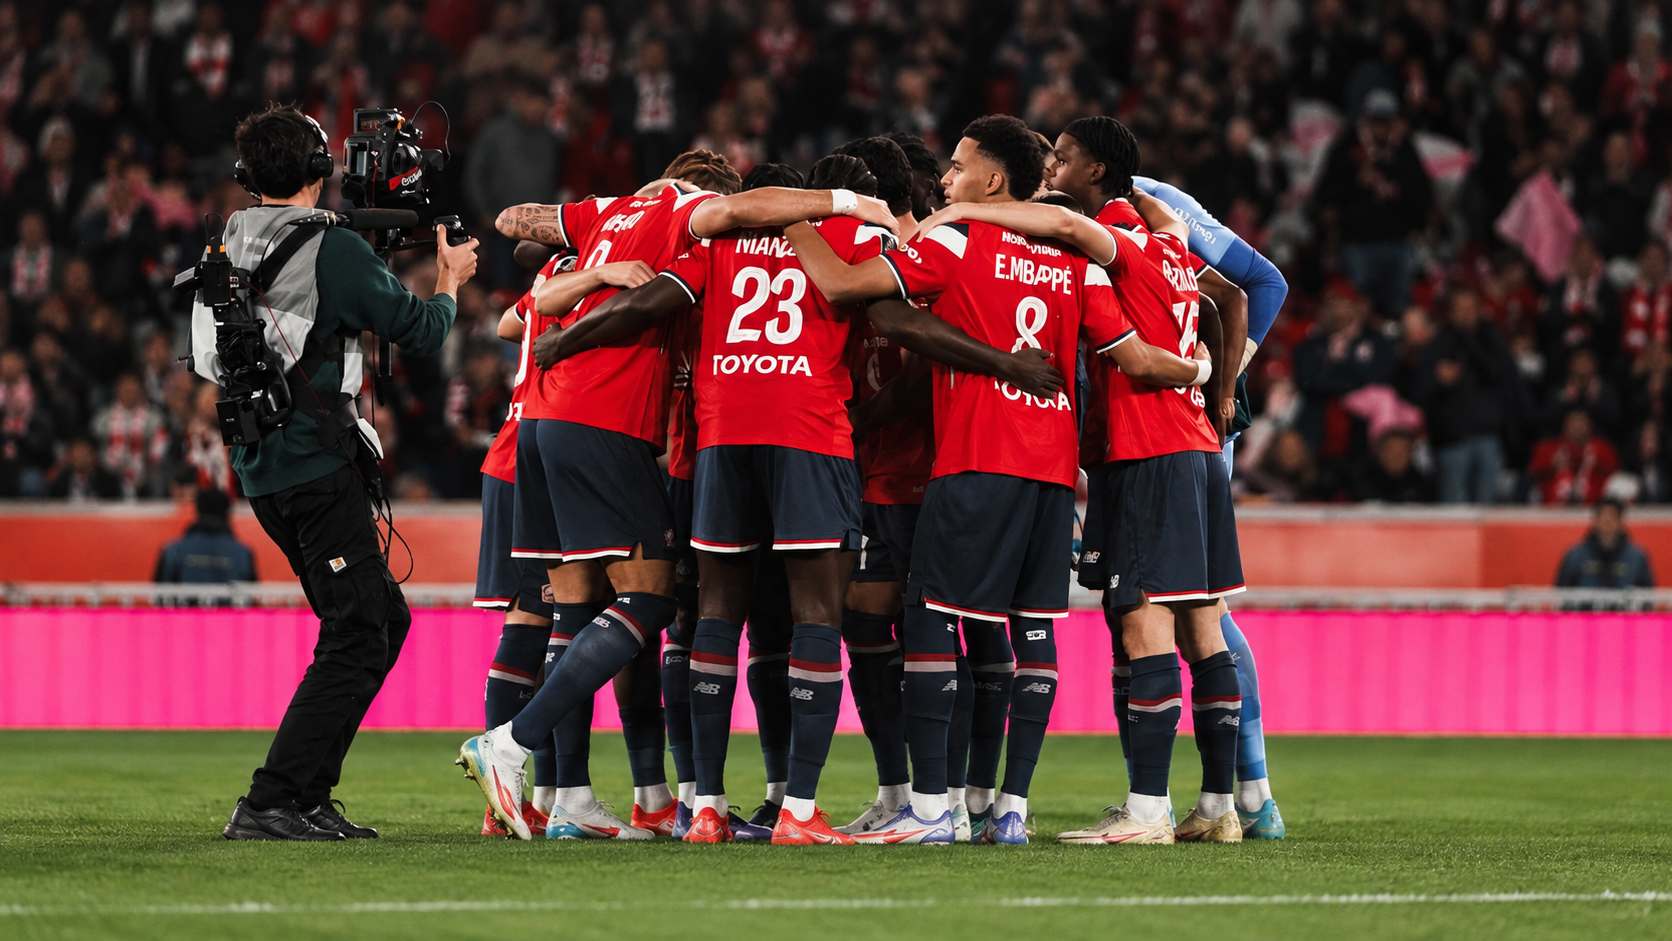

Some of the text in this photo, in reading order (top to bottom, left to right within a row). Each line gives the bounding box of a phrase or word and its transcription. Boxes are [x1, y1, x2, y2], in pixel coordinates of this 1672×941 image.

[726, 266, 807, 345] 23
[1011, 296, 1048, 354] 8
[713, 354, 813, 377] TOYOTA
